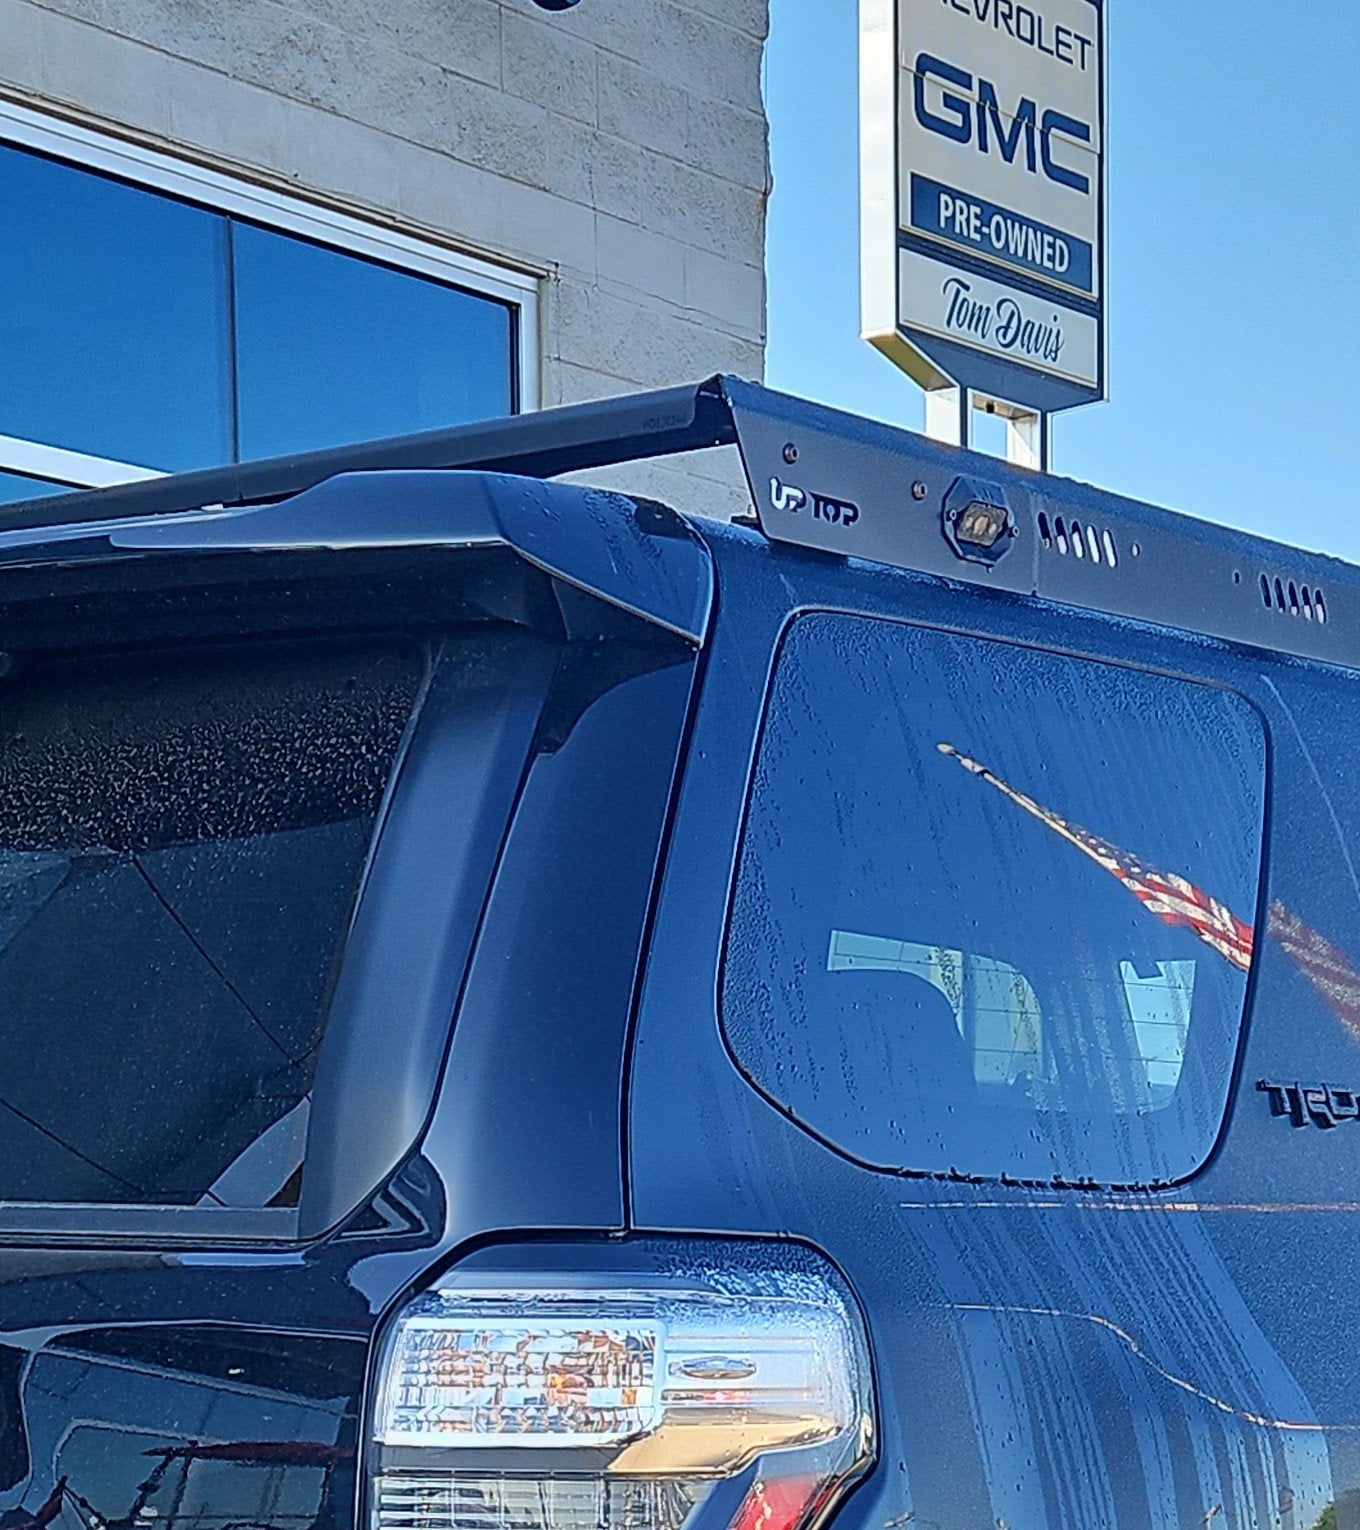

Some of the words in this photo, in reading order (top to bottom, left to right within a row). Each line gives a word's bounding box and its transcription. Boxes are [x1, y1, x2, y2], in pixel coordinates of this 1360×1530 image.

[941, 0, 1093, 70] VROLET
[914, 52, 1090, 195] GMC
[939, 192, 1070, 273] PRE-OWNED
[942, 277, 993, 340] Tom
[995, 297, 1065, 363] Davis
[1256, 1079, 1358, 1128] TRD
